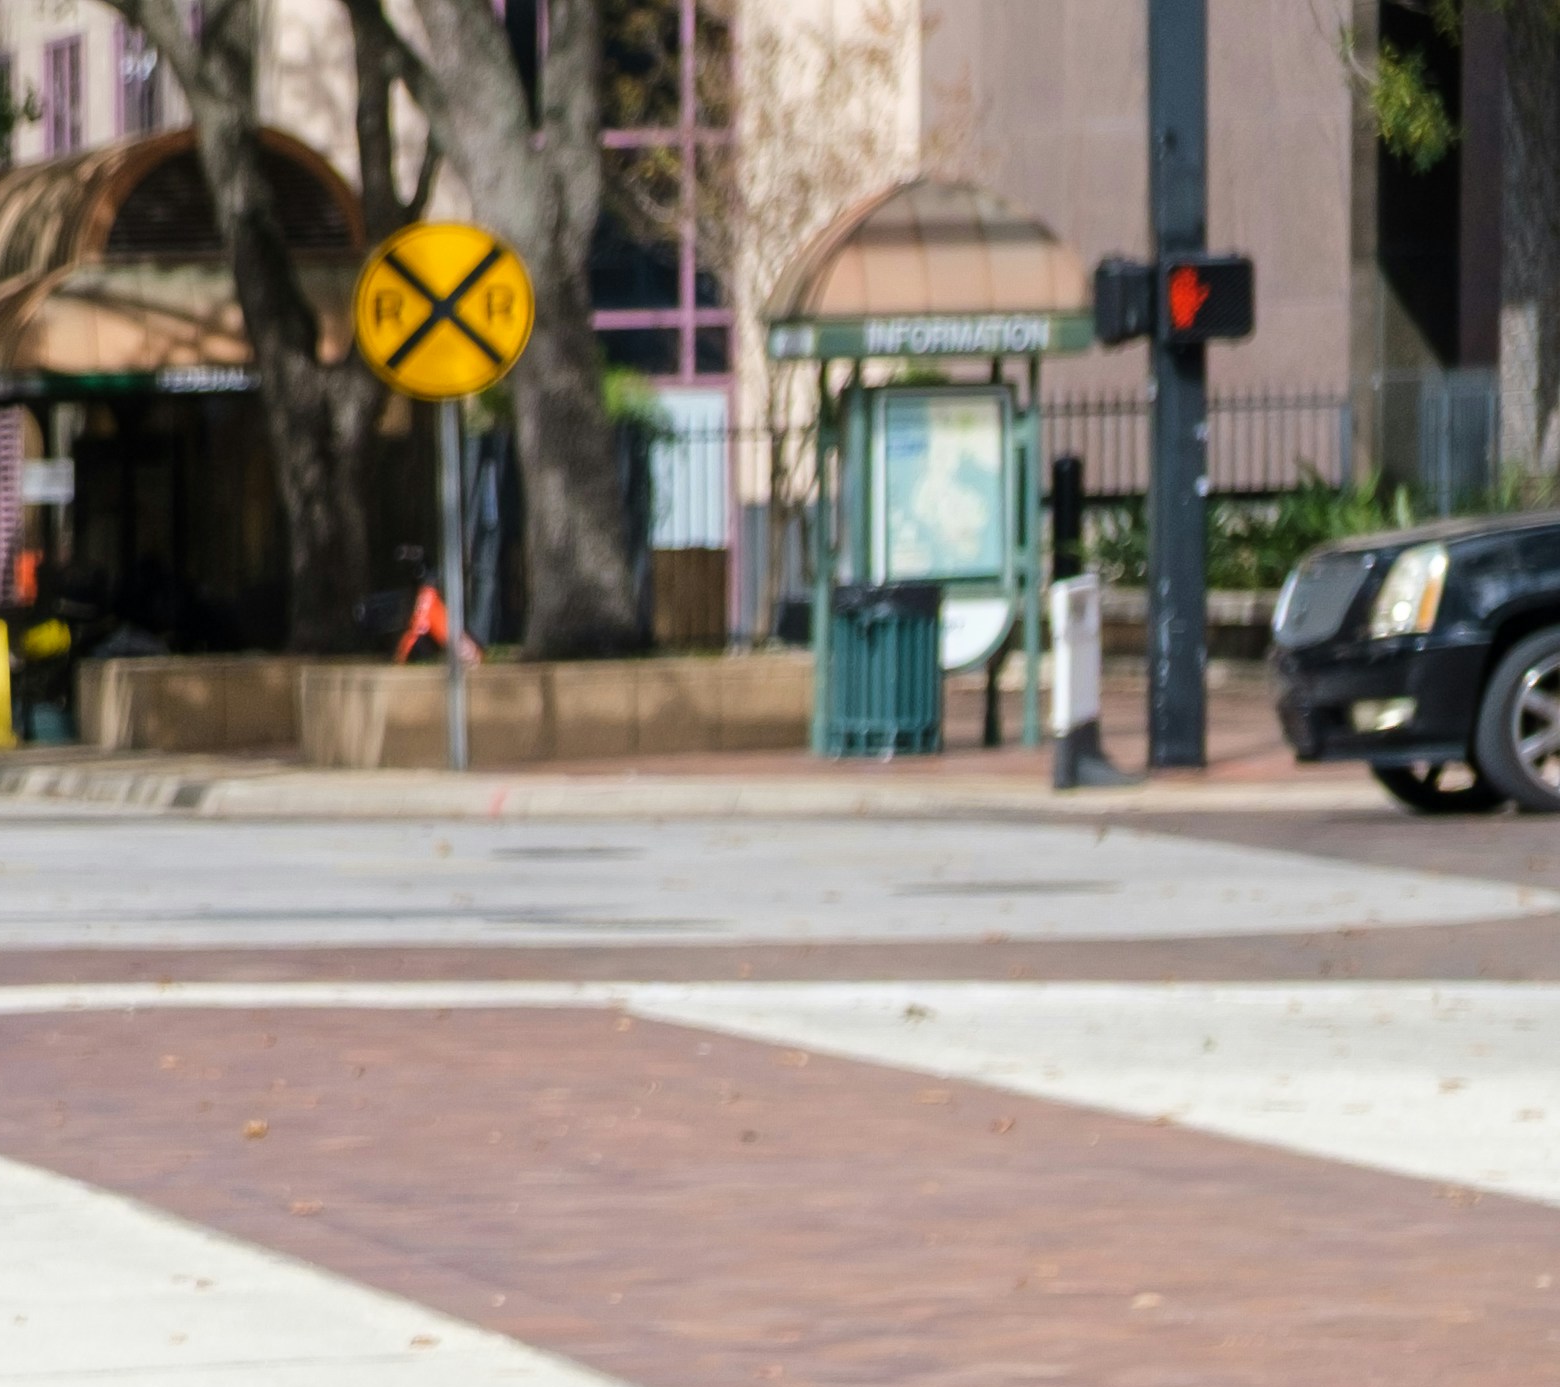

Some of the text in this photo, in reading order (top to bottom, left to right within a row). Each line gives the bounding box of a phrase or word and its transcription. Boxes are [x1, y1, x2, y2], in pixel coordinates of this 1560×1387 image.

[374, 284, 515, 329] R R
[864, 315, 1050, 354] INFORMATION
